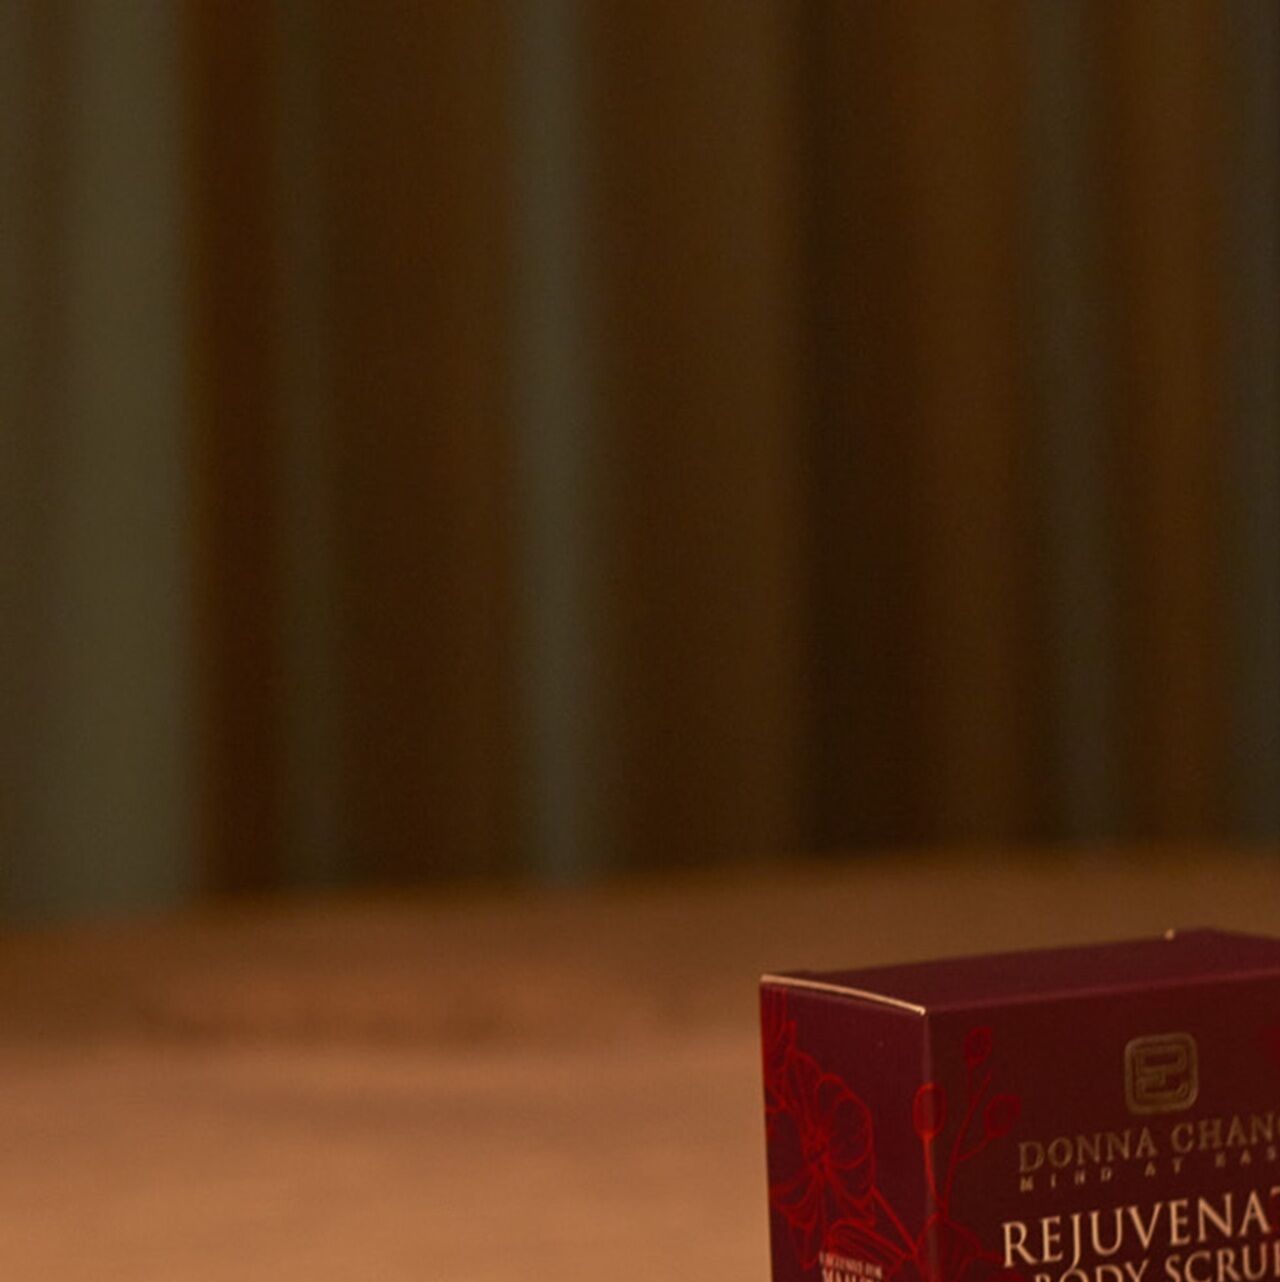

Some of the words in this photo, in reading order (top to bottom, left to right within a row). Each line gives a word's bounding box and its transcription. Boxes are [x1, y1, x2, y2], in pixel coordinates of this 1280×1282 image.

[1018, 1125, 1158, 1175] DONNA
[1018, 1166, 1112, 1193] MIND
[1143, 1159, 1182, 1179] AT
